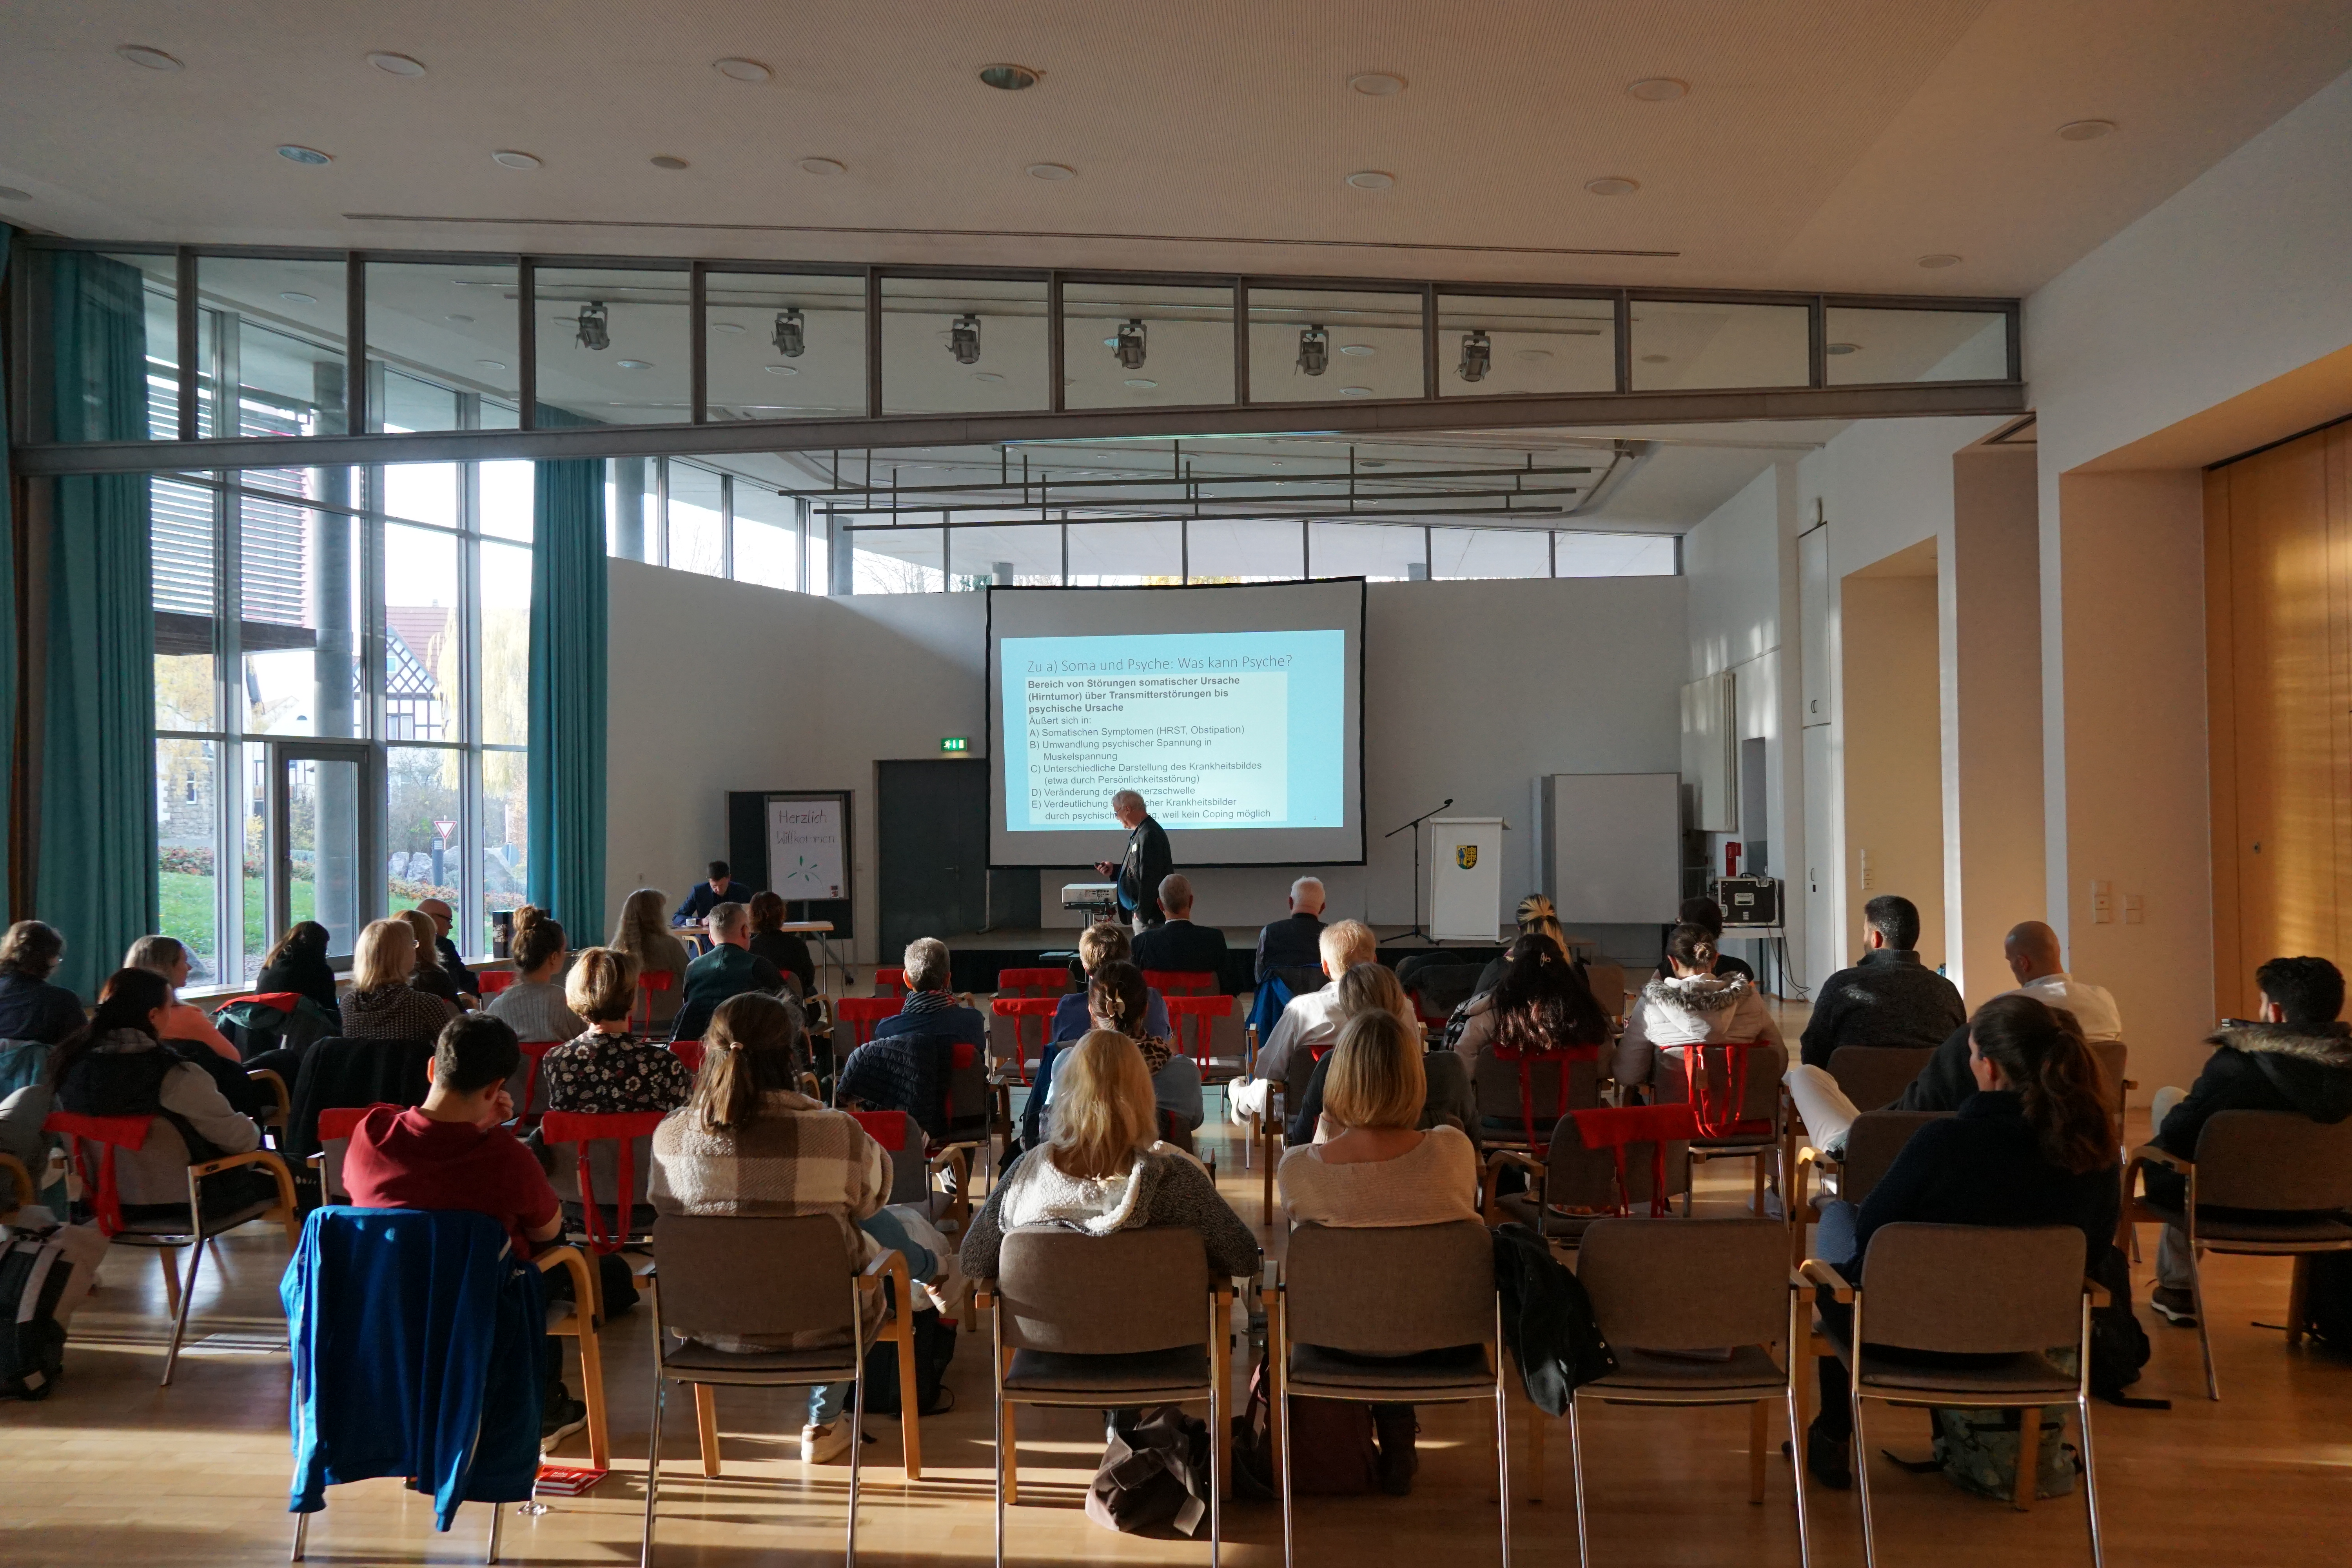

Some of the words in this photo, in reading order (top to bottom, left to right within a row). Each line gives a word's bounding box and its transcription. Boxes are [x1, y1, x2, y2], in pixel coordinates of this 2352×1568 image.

[1027, 661, 1042, 672] Zu
[1046, 660, 1057, 674] a)
[1062, 660, 1096, 671] Soma
[1100, 659, 1123, 671] und
[1128, 657, 1173, 672] Psyche:
[1178, 657, 1204, 669] Was
[1209, 656, 1238, 668] kann
[1243, 655, 1292, 670] Psyche?
[1028, 680, 1063, 689] Bereich
[1087, 679, 1136, 689] Störungen
[1139, 677, 1198, 686] somatischer
[1200, 676, 1240, 685] Ursache
[1028, 692, 1082, 702] (Hirntumor)
[1085, 691, 1106, 700] über
[1109, 690, 1211, 700] Transmitterstörungen
[1214, 689, 1229, 697] bis
[1029, 704, 1082, 715] psychische
[1085, 703, 1123, 711] Ursache
[1029, 715, 1058, 725] Äußert
[1029, 729, 1039, 738] A)
[1042, 728, 1098, 737] Somatischen
[1101, 728, 1153, 737] Symptomen
[1156, 726, 1187, 736] (HRST,
[1191, 725, 1244, 735] Obstipation)
[1030, 741, 1040, 750] B)
[1042, 740, 1099, 750] Umwandlung
[1102, 739, 1154, 749] psychischer
[1156, 739, 1201, 748] Spannung
[1044, 753, 1117, 762] Muskelspannung
[1031, 765, 1041, 774] C)
[1044, 764, 1116, 773] Unterschiedliche
[1118, 763, 1168, 773] Darstellung
[1189, 761, 1262, 770] Krankheitsbildes
[1044, 777, 1068, 786] (etwa
[1098, 775, 1200, 784] Persönlichkeitsstörung)
[1031, 788, 1042, 798] D)
[1044, 788, 1100, 797] Veränderung
[1120, 787, 1195, 795] merzschwelle
[1032, 800, 1041, 809] E)
[1044, 800, 1108, 808] Verdeutlichung
[1166, 798, 1237, 806] Krankheitsbilder
[779, 809, 827, 824] Herzlich
[1073, 811, 1116, 821] psychisch
[1203, 810, 1234, 819] Coping
[1236, 809, 1270, 819] möglich
[777, 831, 835, 844] Willkommen
